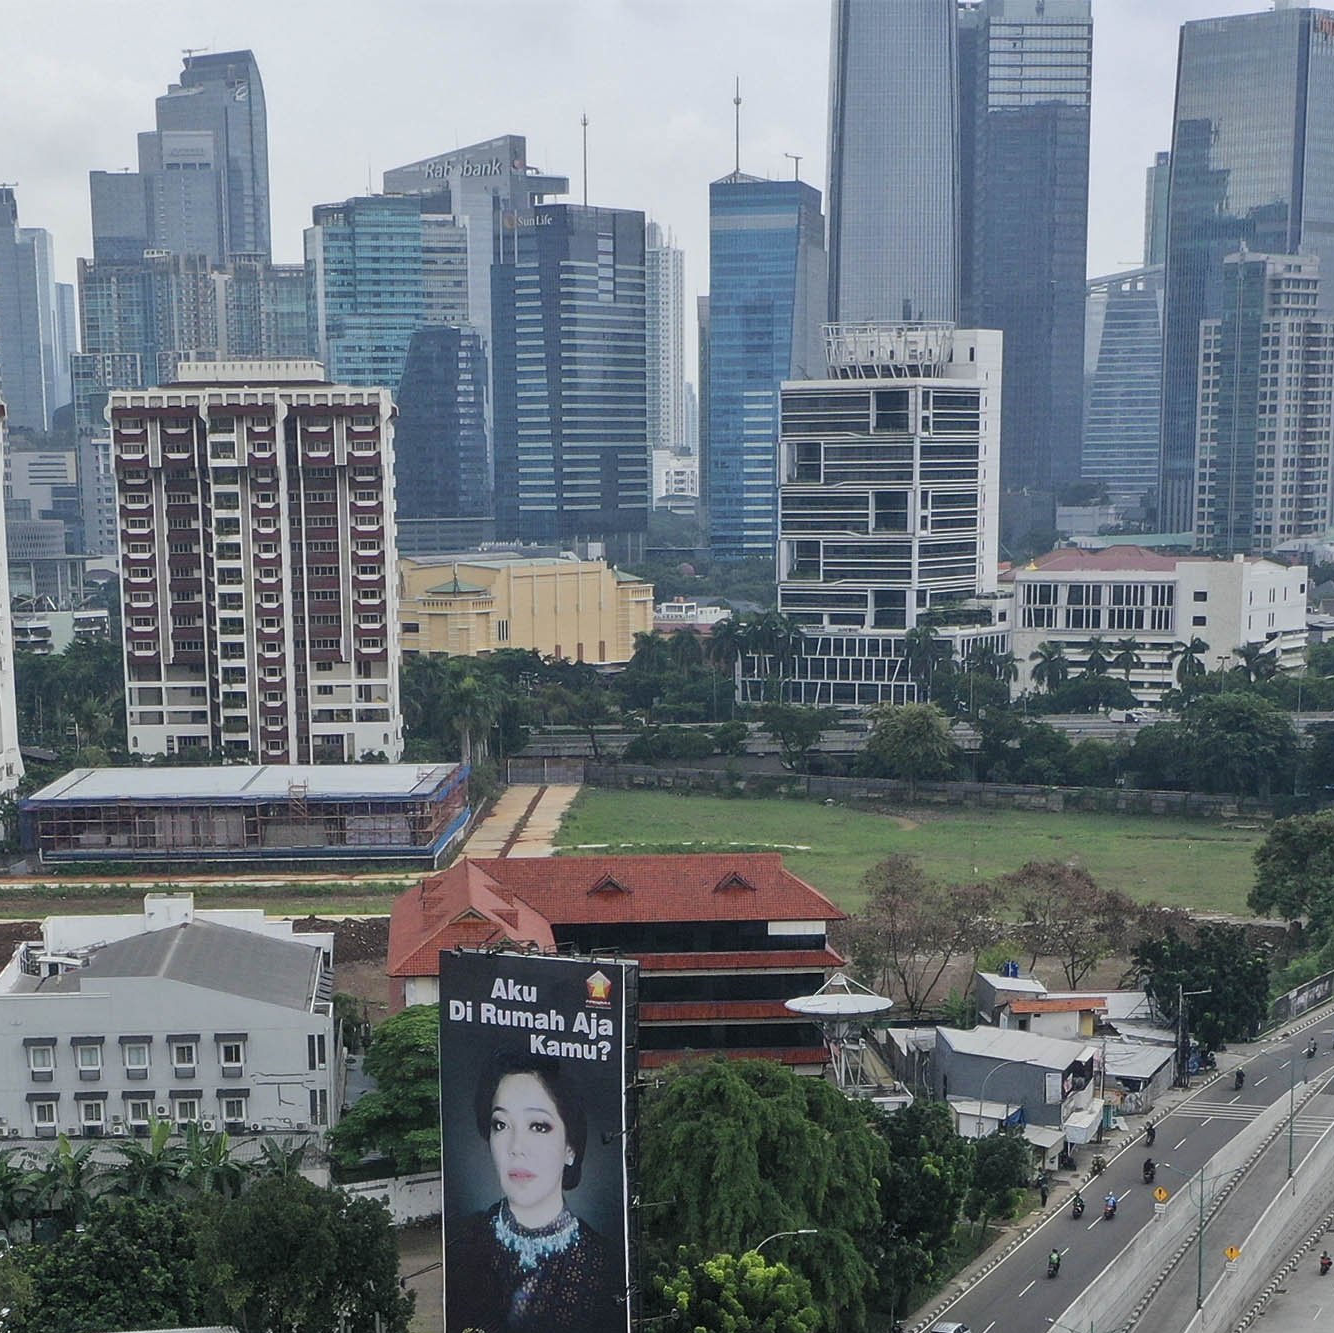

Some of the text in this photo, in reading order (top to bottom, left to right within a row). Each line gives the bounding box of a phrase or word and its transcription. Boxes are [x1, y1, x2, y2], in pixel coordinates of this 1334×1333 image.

[490, 977, 537, 1003] Aku
[449, 999, 613, 1040] Di Rumah Aja
[530, 1034, 612, 1062] Kamu?
